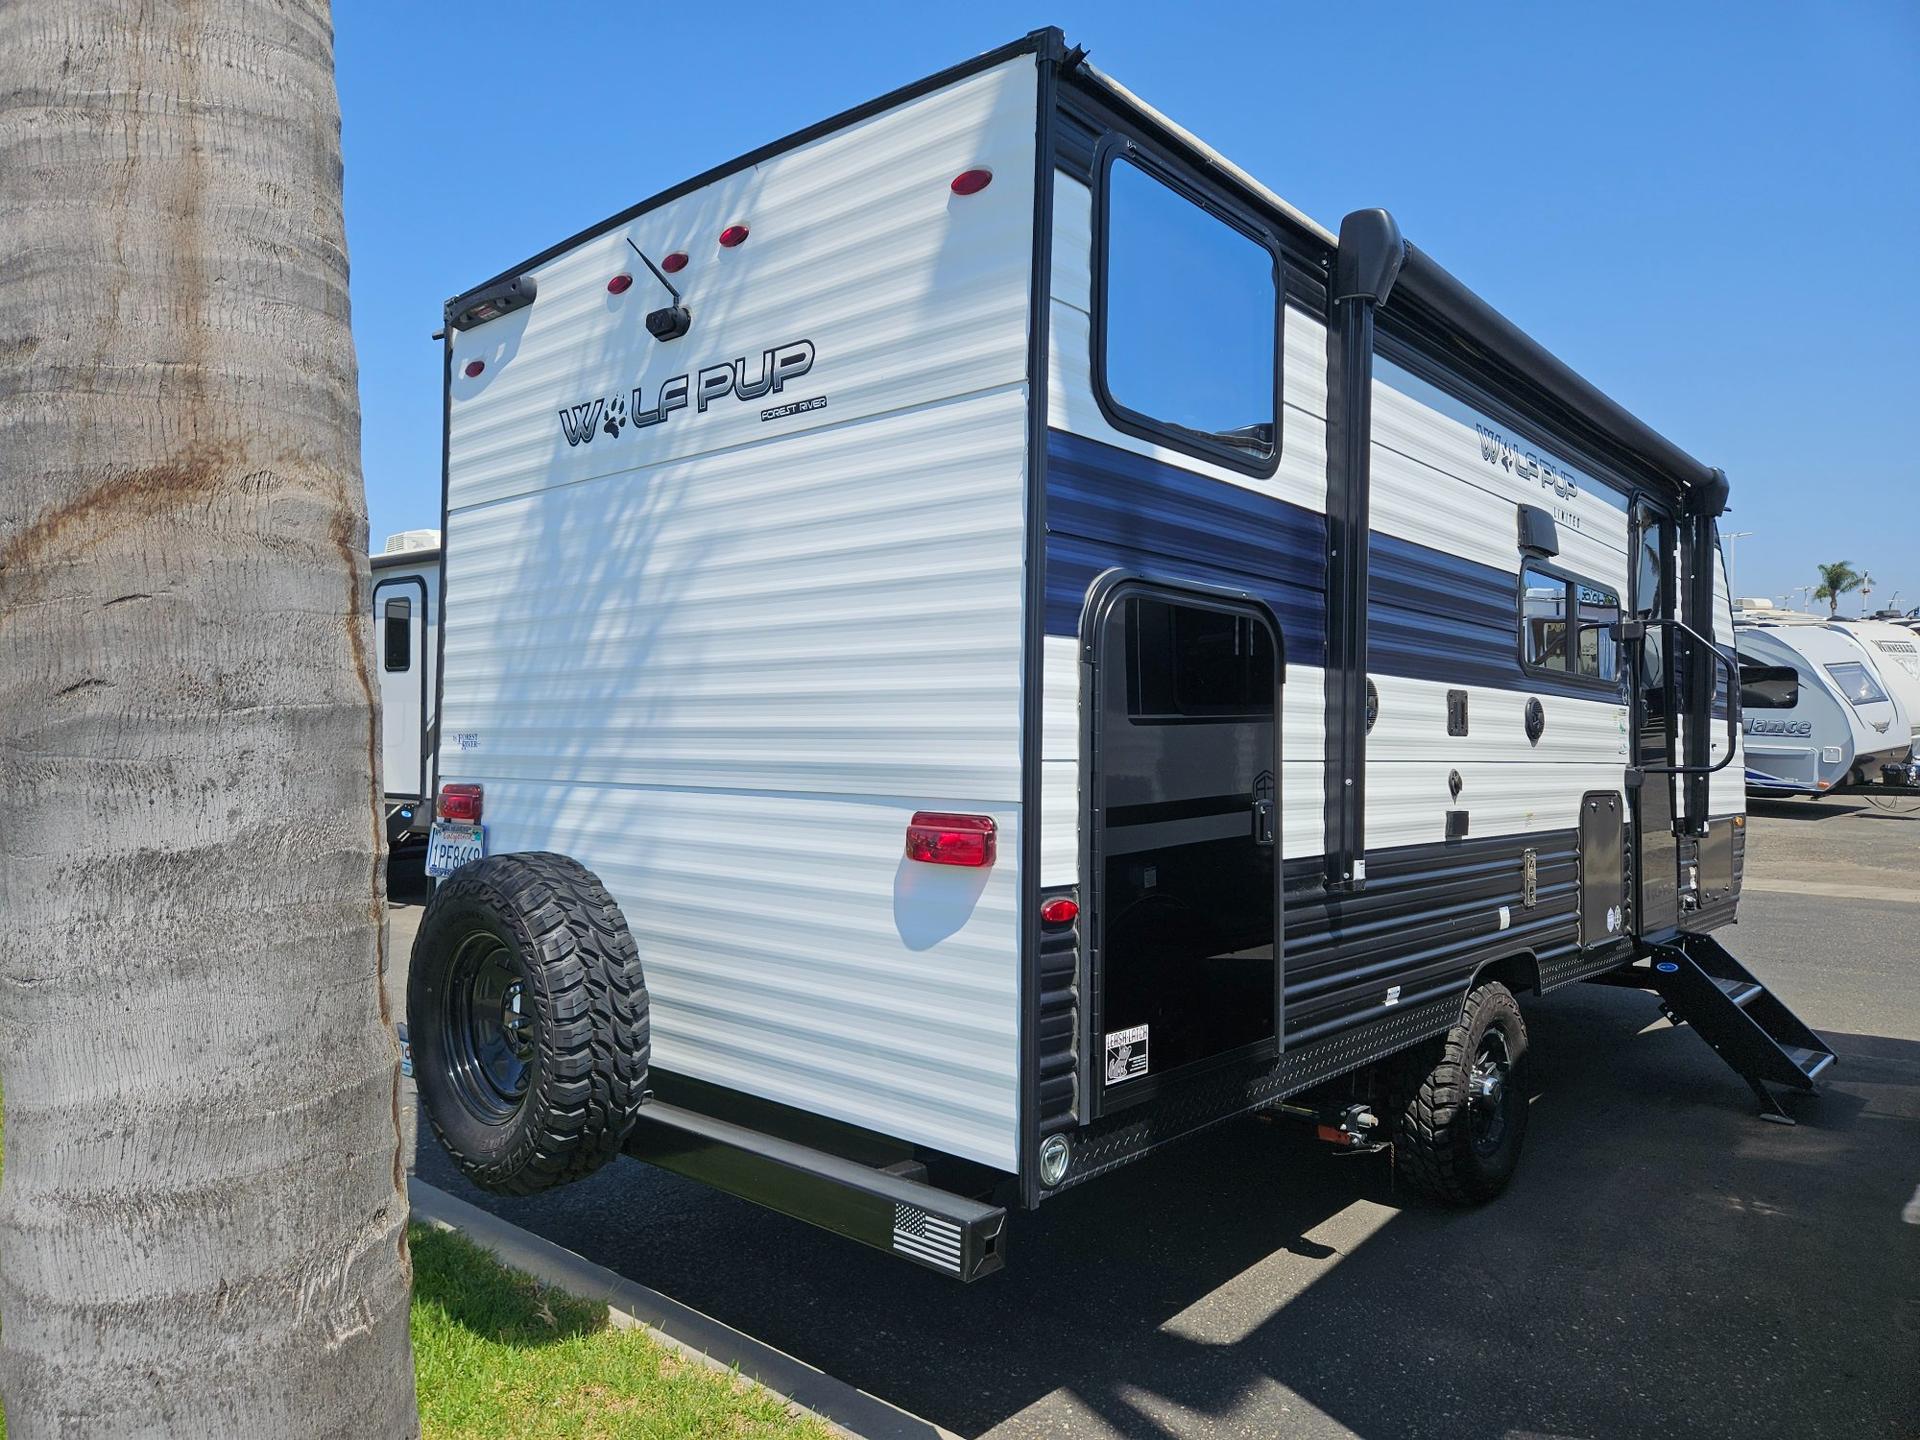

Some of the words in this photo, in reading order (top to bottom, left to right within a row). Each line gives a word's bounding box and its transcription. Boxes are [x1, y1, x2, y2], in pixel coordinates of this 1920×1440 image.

[697, 338, 816, 414] PUP
[761, 403, 797, 421] FOREST
[799, 396, 827, 414] RIVER
[1540, 458, 1579, 501] PUP
[1553, 506, 1581, 529] LIMITED
